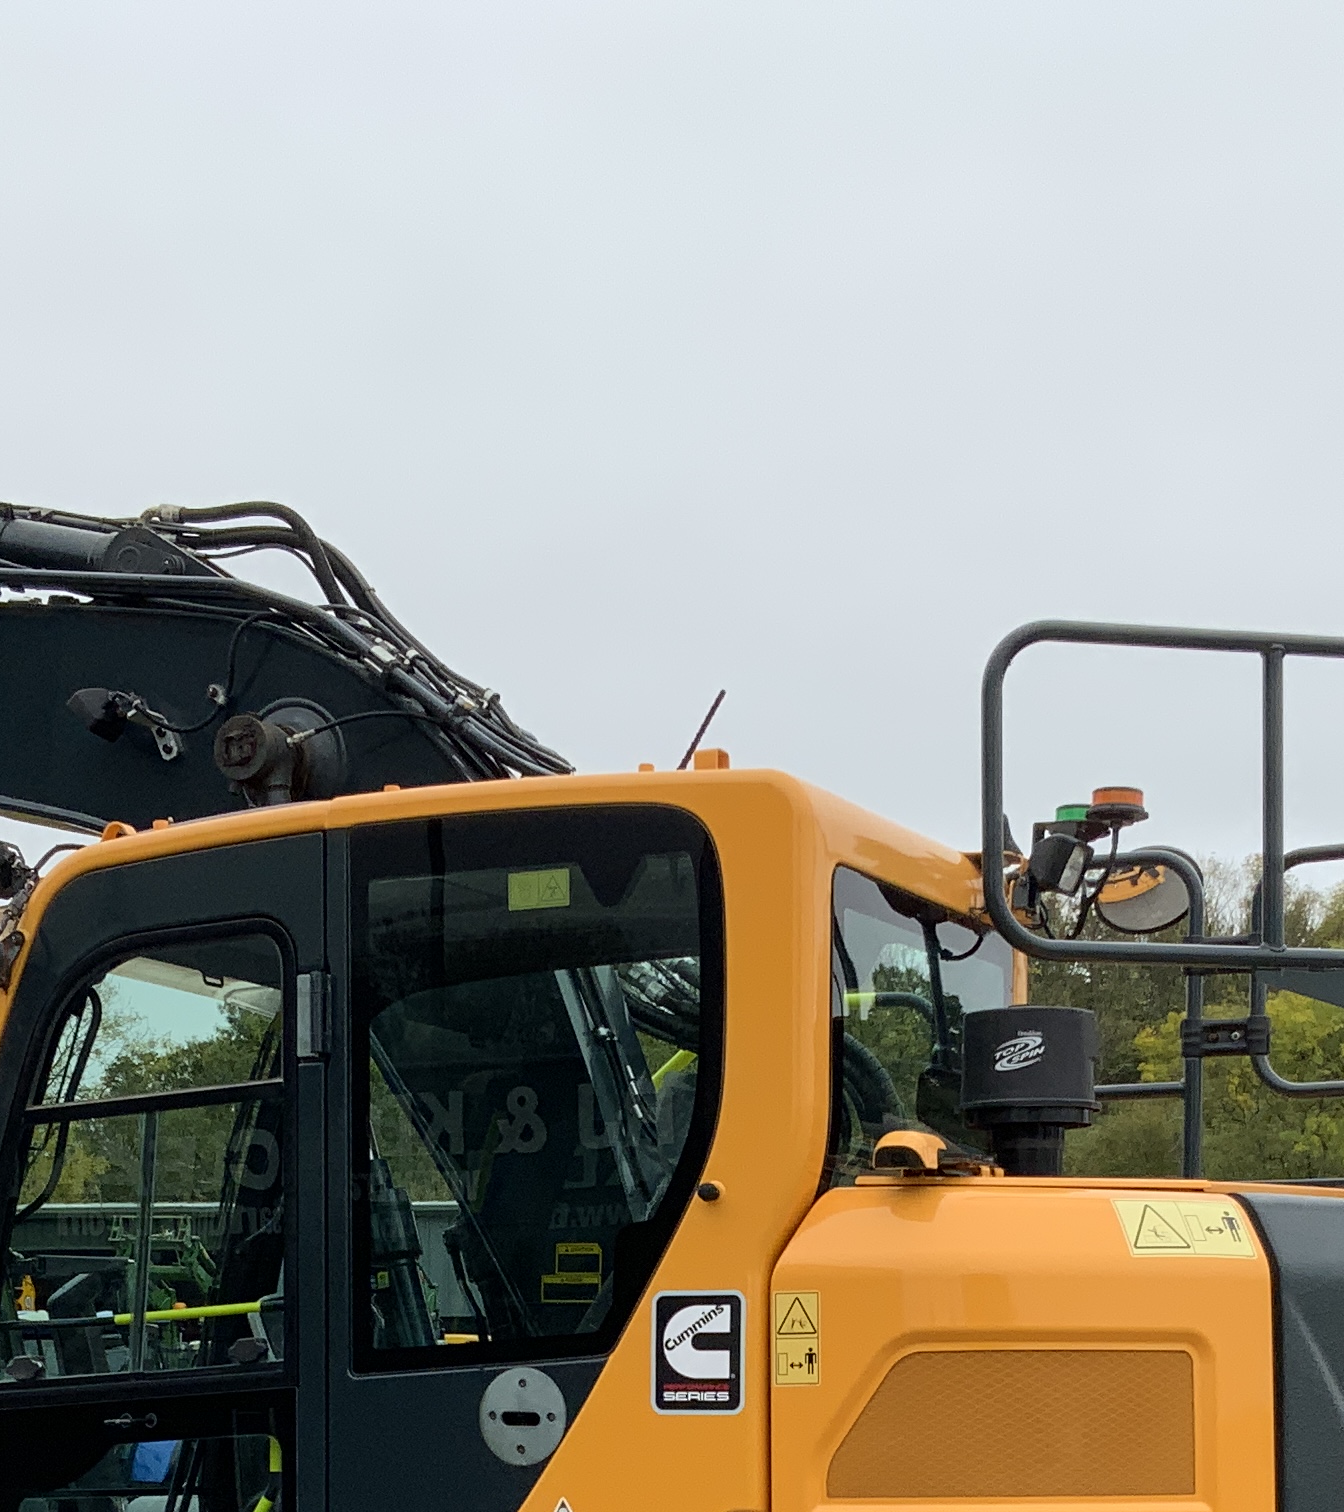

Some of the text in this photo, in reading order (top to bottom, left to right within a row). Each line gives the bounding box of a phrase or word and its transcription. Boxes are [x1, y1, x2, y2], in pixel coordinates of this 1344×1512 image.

[994, 1043, 1025, 1060] TOP
[1011, 1046, 1045, 1064] SPIN
[664, 1304, 725, 1352] Cummins
[663, 1391, 729, 1402] SERIES
